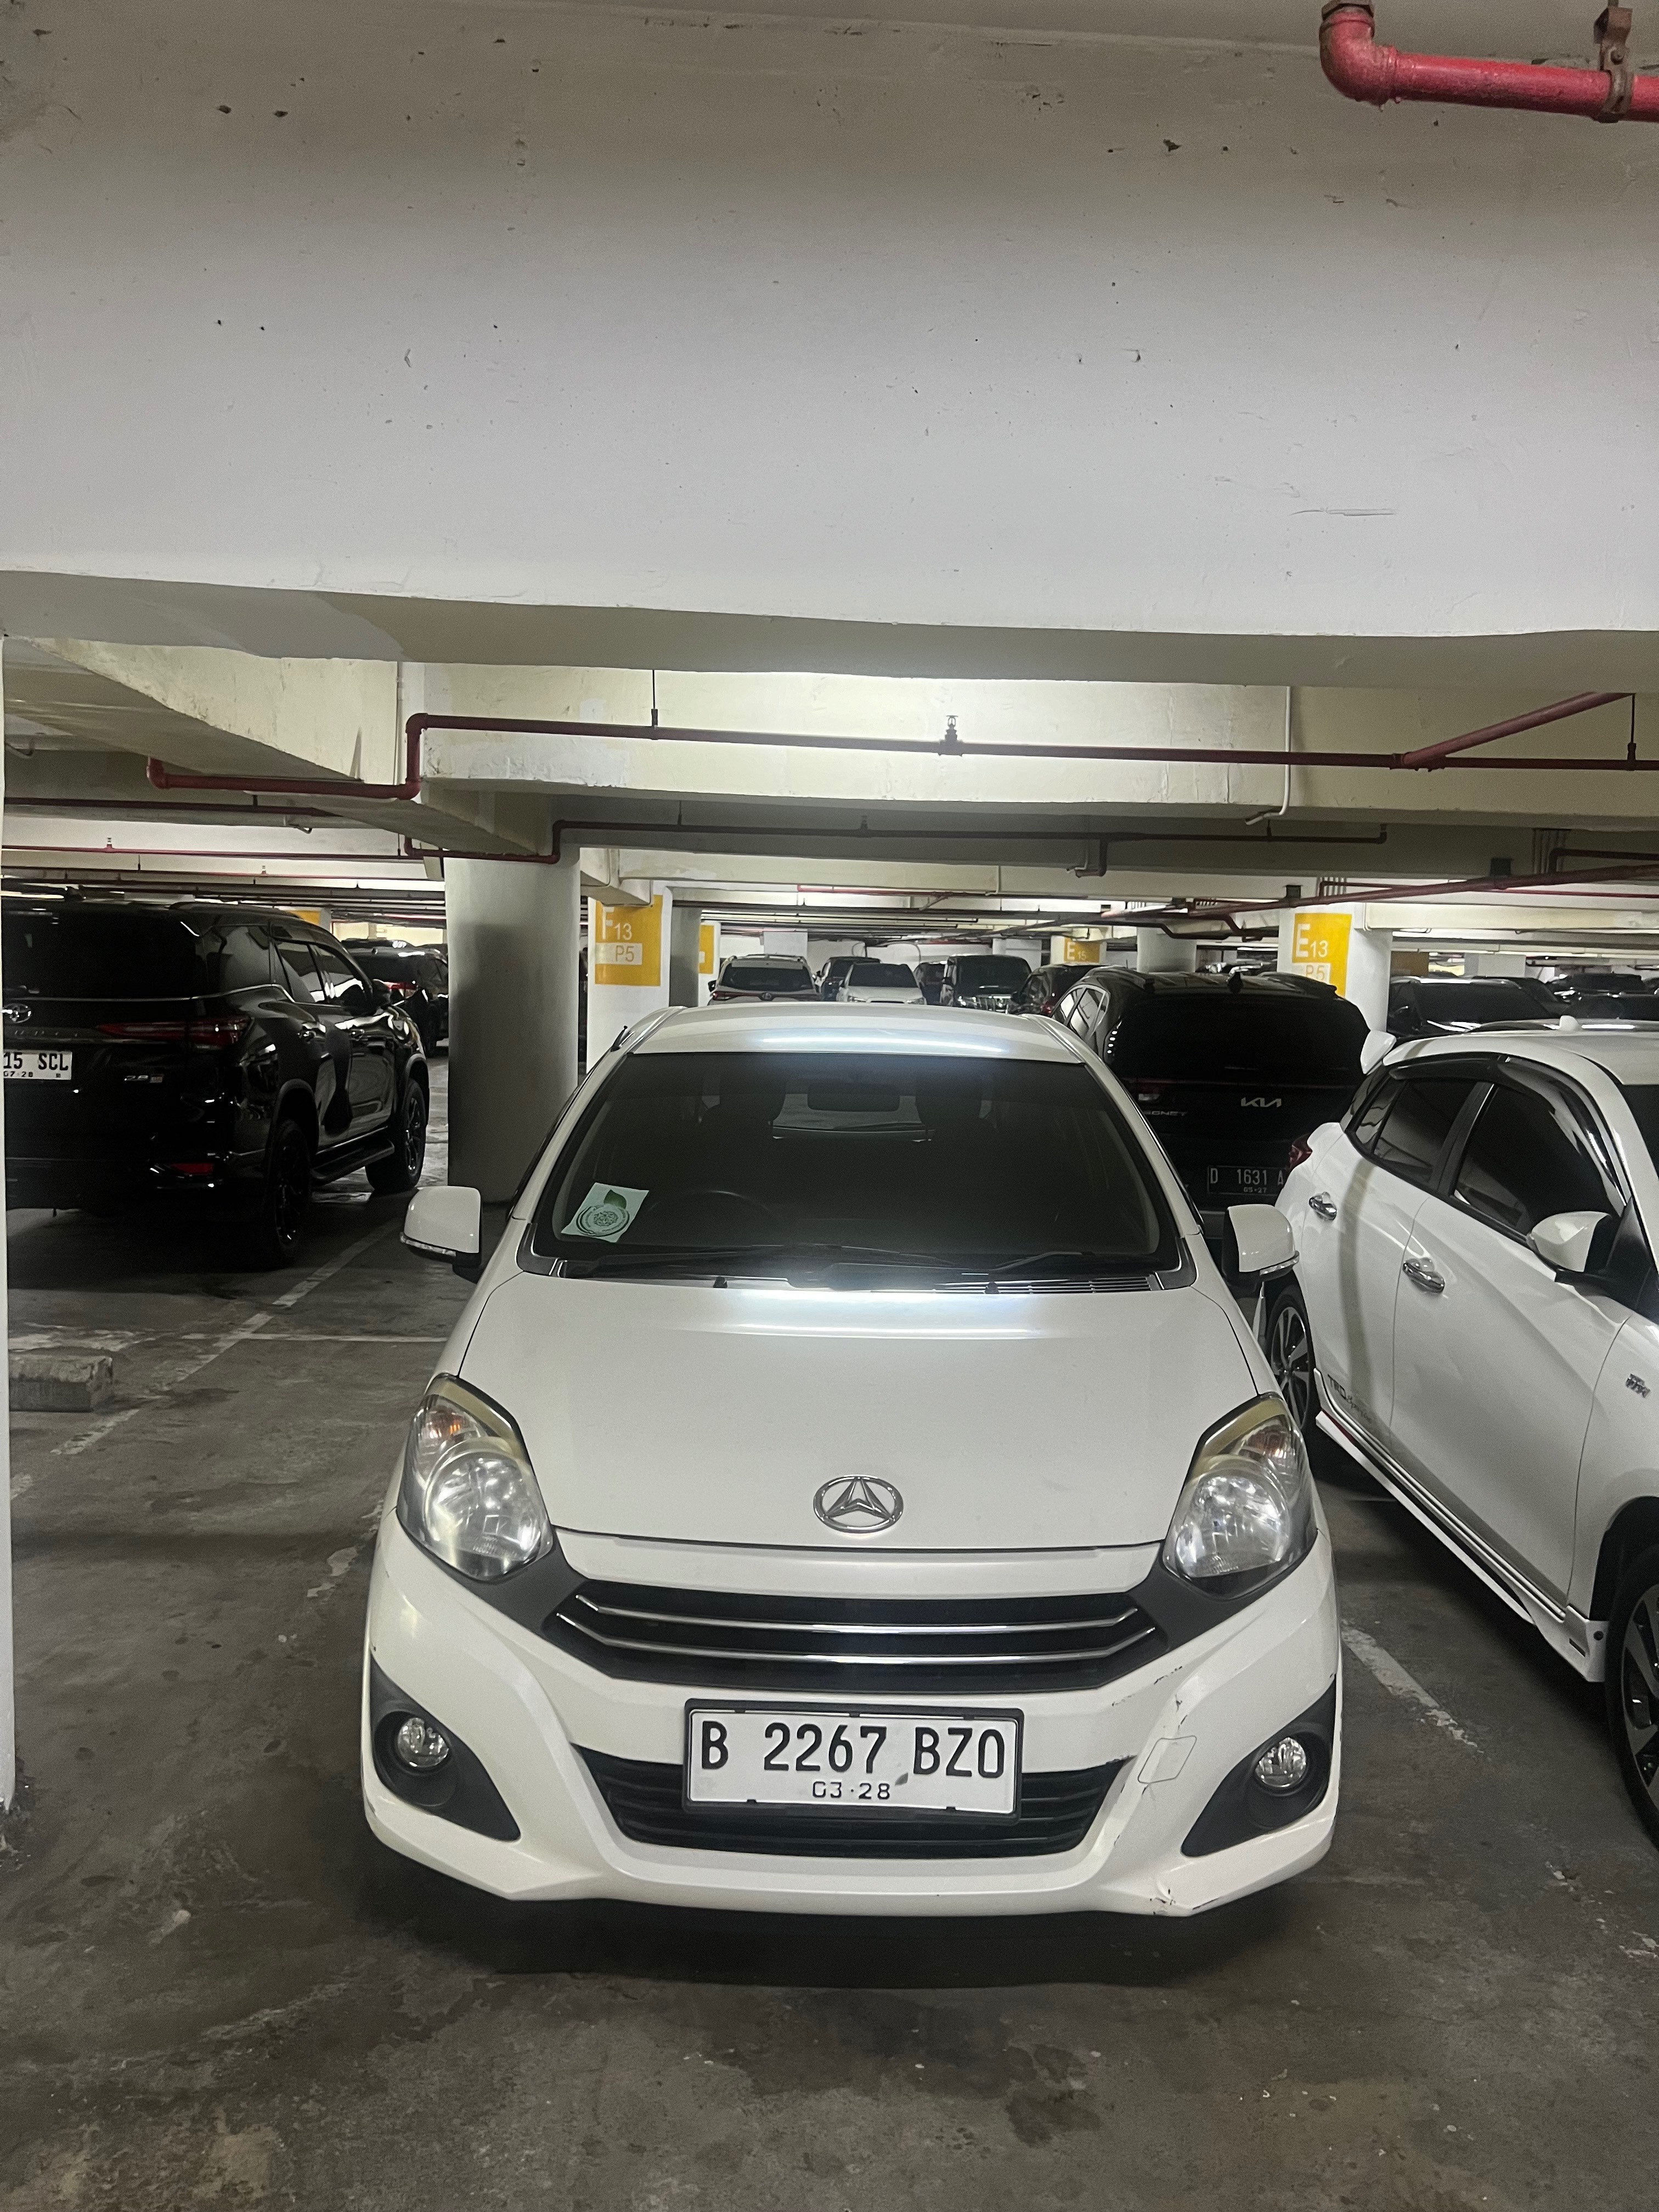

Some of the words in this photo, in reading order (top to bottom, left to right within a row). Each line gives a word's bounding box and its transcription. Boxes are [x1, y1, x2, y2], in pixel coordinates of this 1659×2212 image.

[616, 945, 635, 962] P5
[38, 1053, 69, 1071] SCL
[1240, 1097, 1282, 1108] KIA
[1210, 1167, 1218, 1184] D
[1237, 1169, 1267, 1186] 1631
[701, 1720, 729, 1770] B
[763, 1722, 888, 1774] 2267
